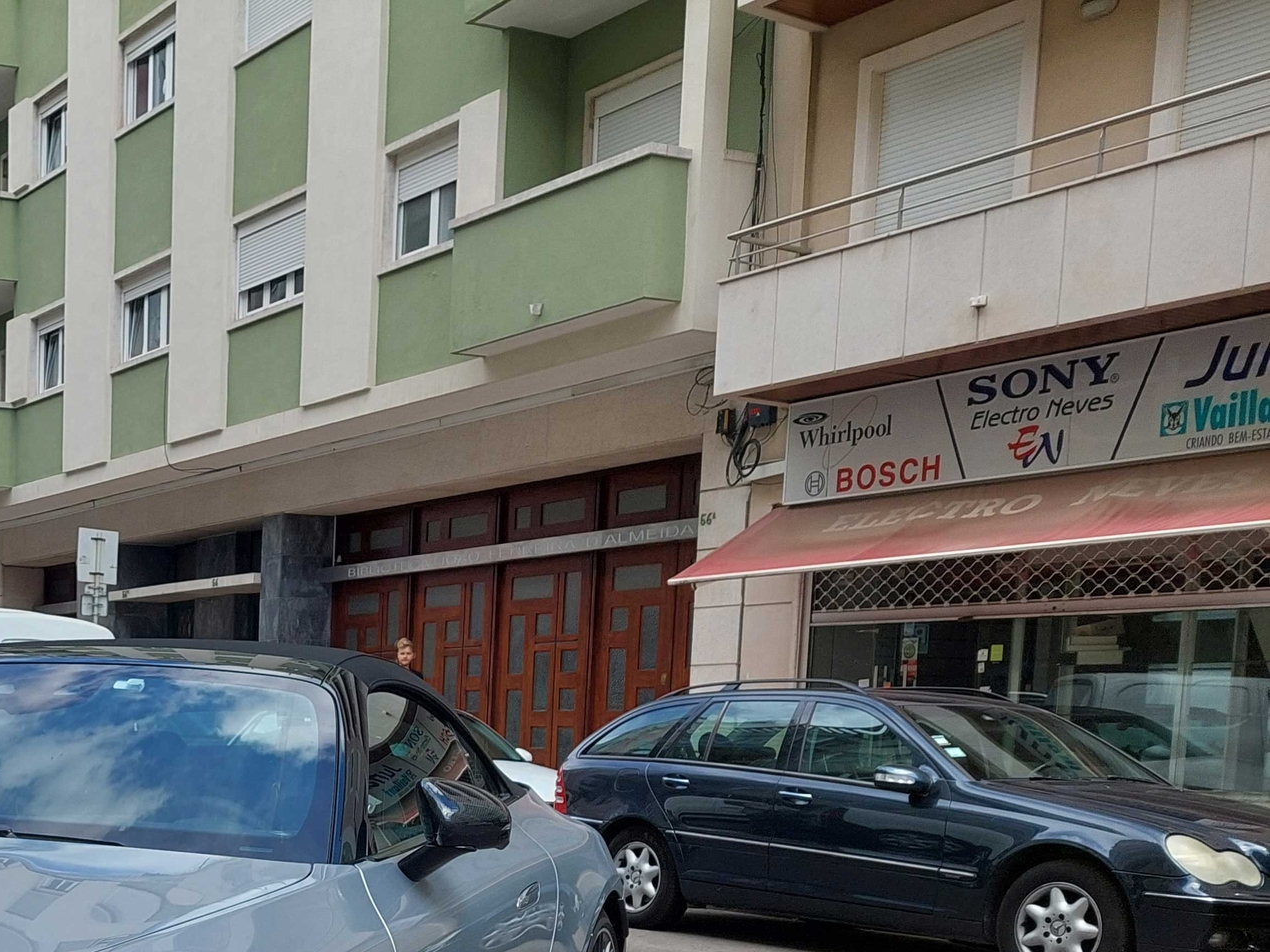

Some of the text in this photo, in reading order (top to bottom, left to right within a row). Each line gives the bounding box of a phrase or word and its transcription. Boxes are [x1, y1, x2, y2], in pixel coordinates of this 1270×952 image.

[967, 352, 1120, 407] SONY
[799, 414, 892, 449] Whirlpool
[970, 394, 1115, 431] Electro Neves
[1186, 434, 1224, 449] CRIANDO
[836, 454, 941, 493] BOSCH
[821, 494, 1043, 533] ELECTRO
